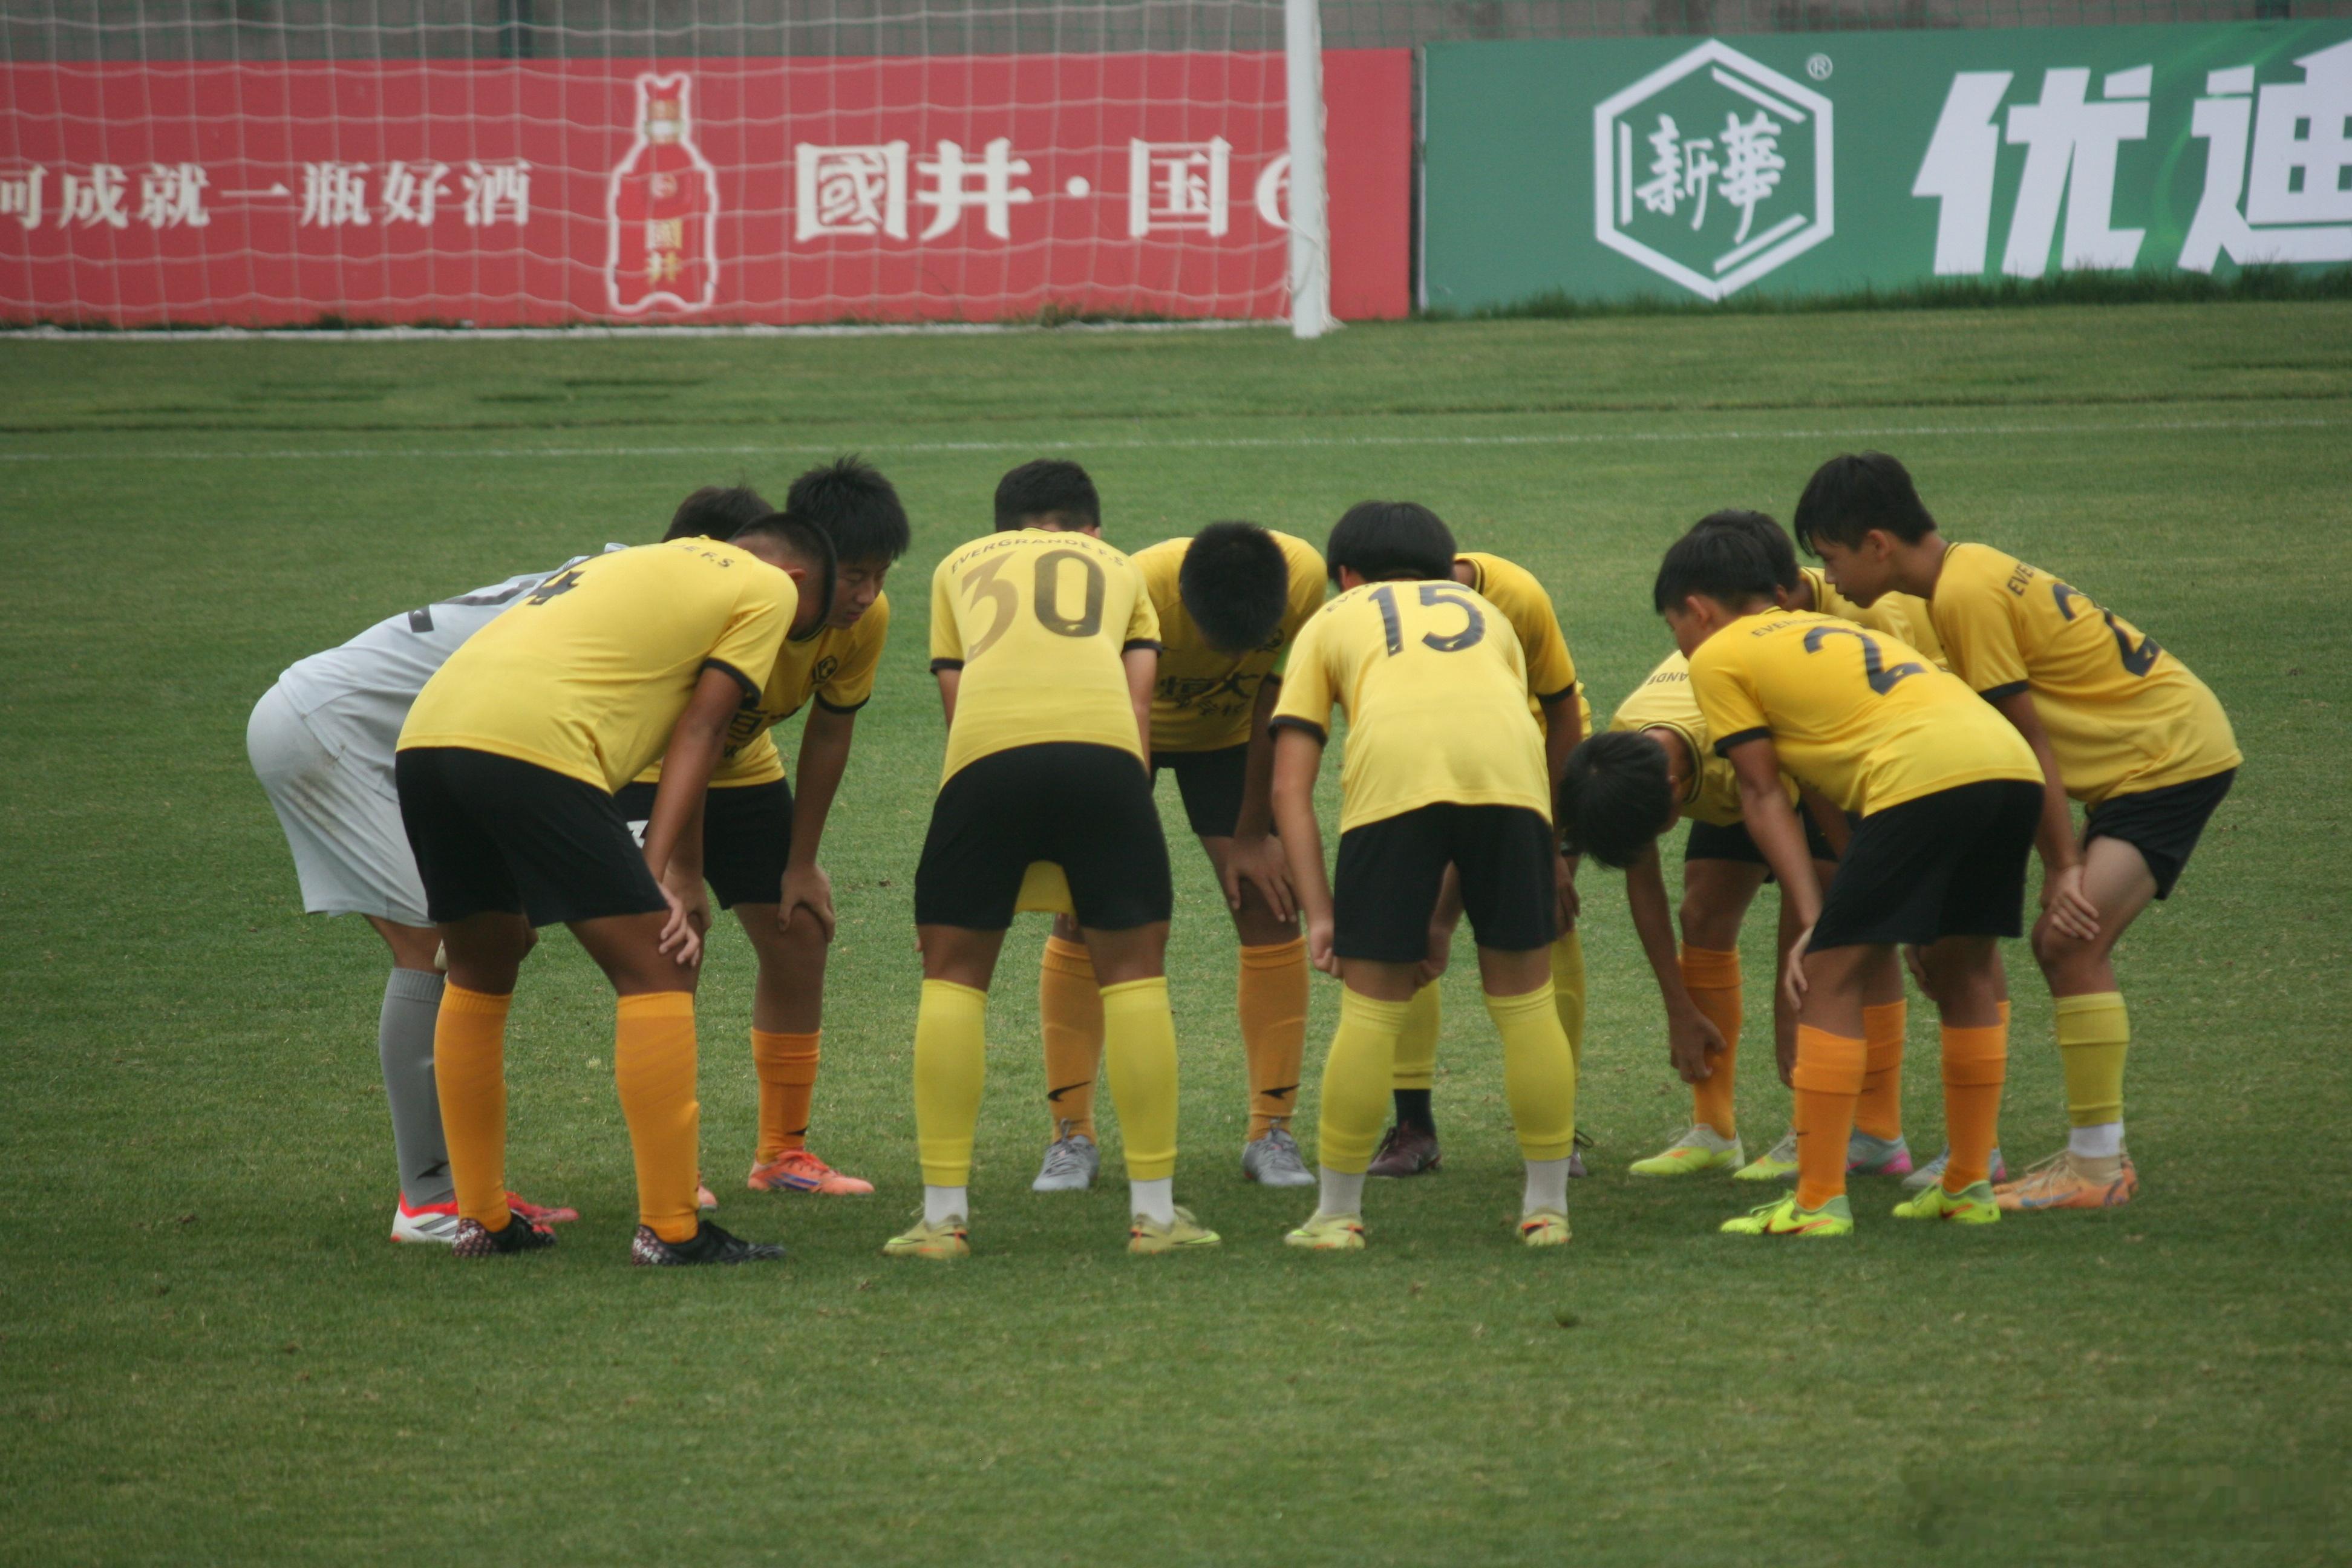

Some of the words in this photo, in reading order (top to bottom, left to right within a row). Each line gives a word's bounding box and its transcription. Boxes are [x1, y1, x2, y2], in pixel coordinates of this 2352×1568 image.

[952, 538, 1091, 575] EVERGRANDE
[961, 549, 1106, 665] 30
[1368, 582, 1486, 658] 15
[1803, 626, 1929, 696] 2
